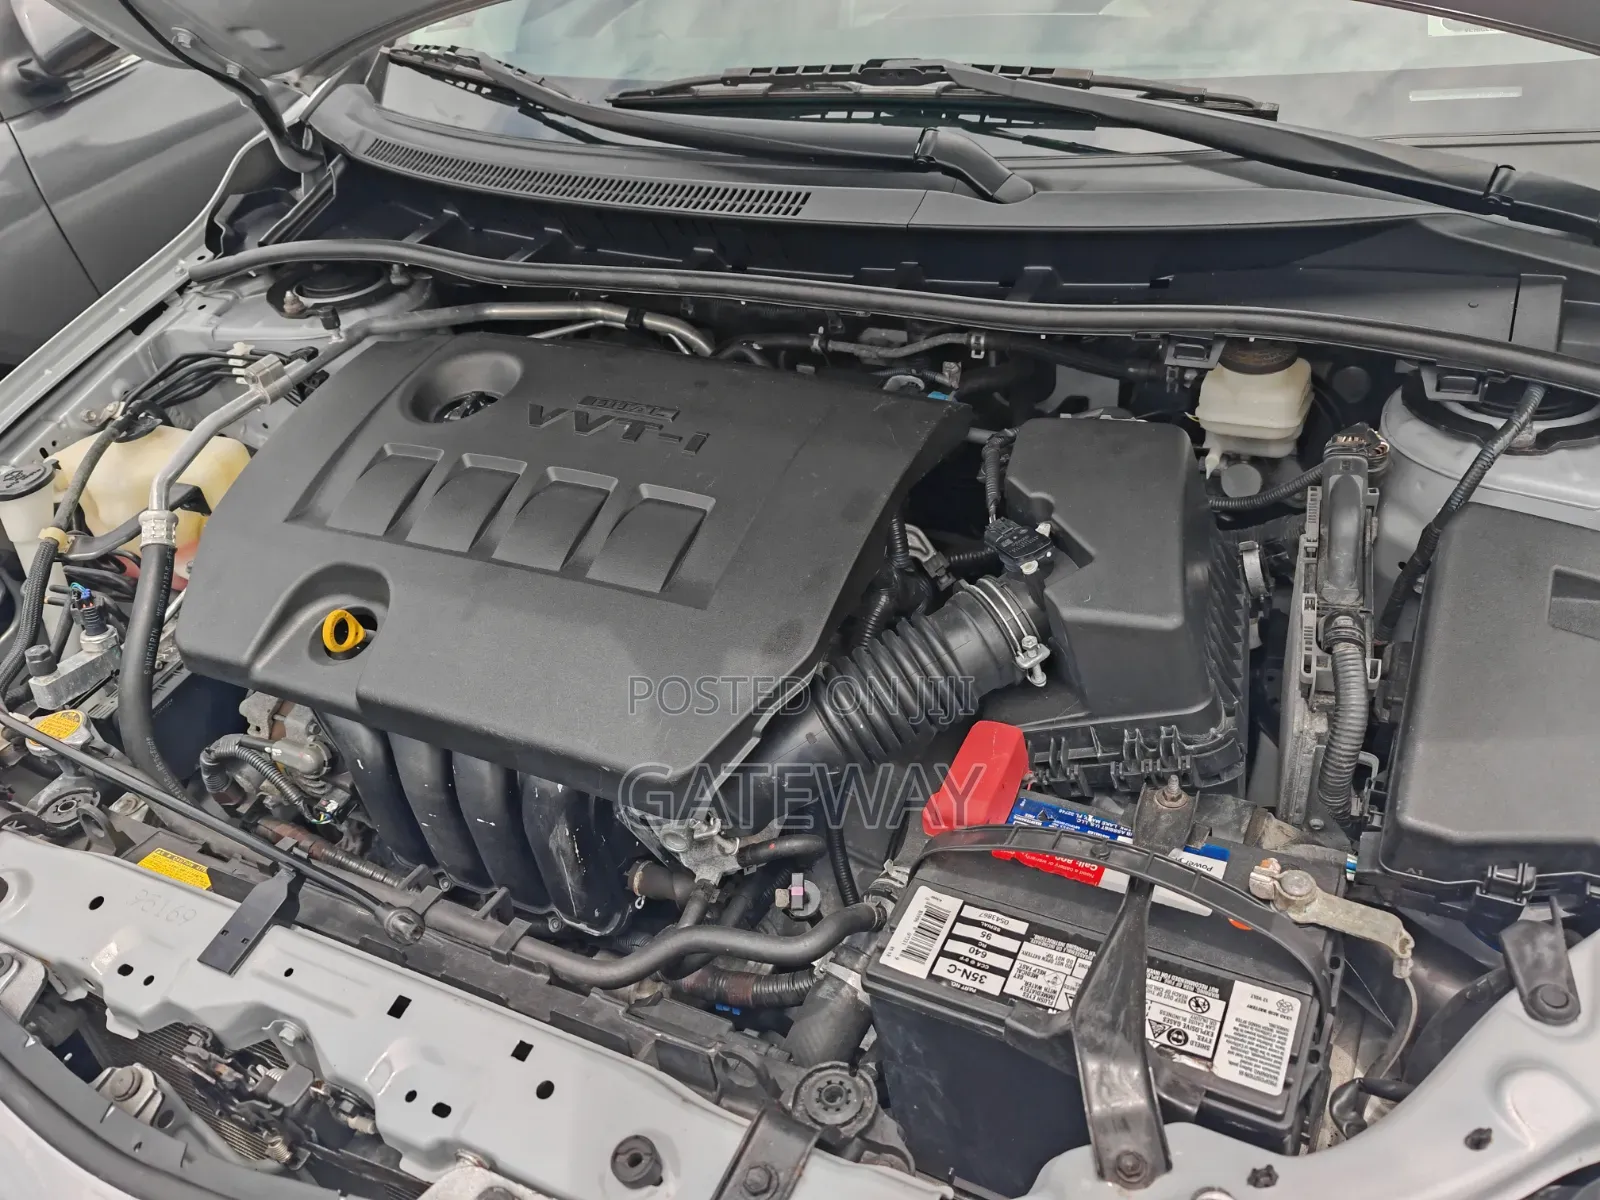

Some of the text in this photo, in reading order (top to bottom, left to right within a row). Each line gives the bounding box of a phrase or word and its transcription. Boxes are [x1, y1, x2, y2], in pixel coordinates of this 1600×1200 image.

[591, 398, 667, 417] DUAL
[978, 911, 1009, 925] 0543867
[980, 921, 1000, 931] SERIAL
[979, 930, 992, 940] 95
[968, 946, 987, 958] 640
[976, 961, 989, 969] CCA
[946, 963, 987, 984] 35N-C
[1016, 967, 1038, 978] MEDICAL
[1033, 967, 1046, 975] HELP
[961, 984, 976, 993] PART
[1019, 985, 1055, 1000] IMMEDIATELY
[1022, 991, 1036, 999] EYES
[1171, 990, 1188, 999] REACH
[1159, 1009, 1187, 1021] BLINDNESS
[1162, 1016, 1214, 1036] EXPLOSIVE GASES
[1188, 1018, 1204, 1026] CAUSE
[1195, 1033, 1212, 1043] EYES.
[1189, 1040, 1210, 1050] SHIELD
